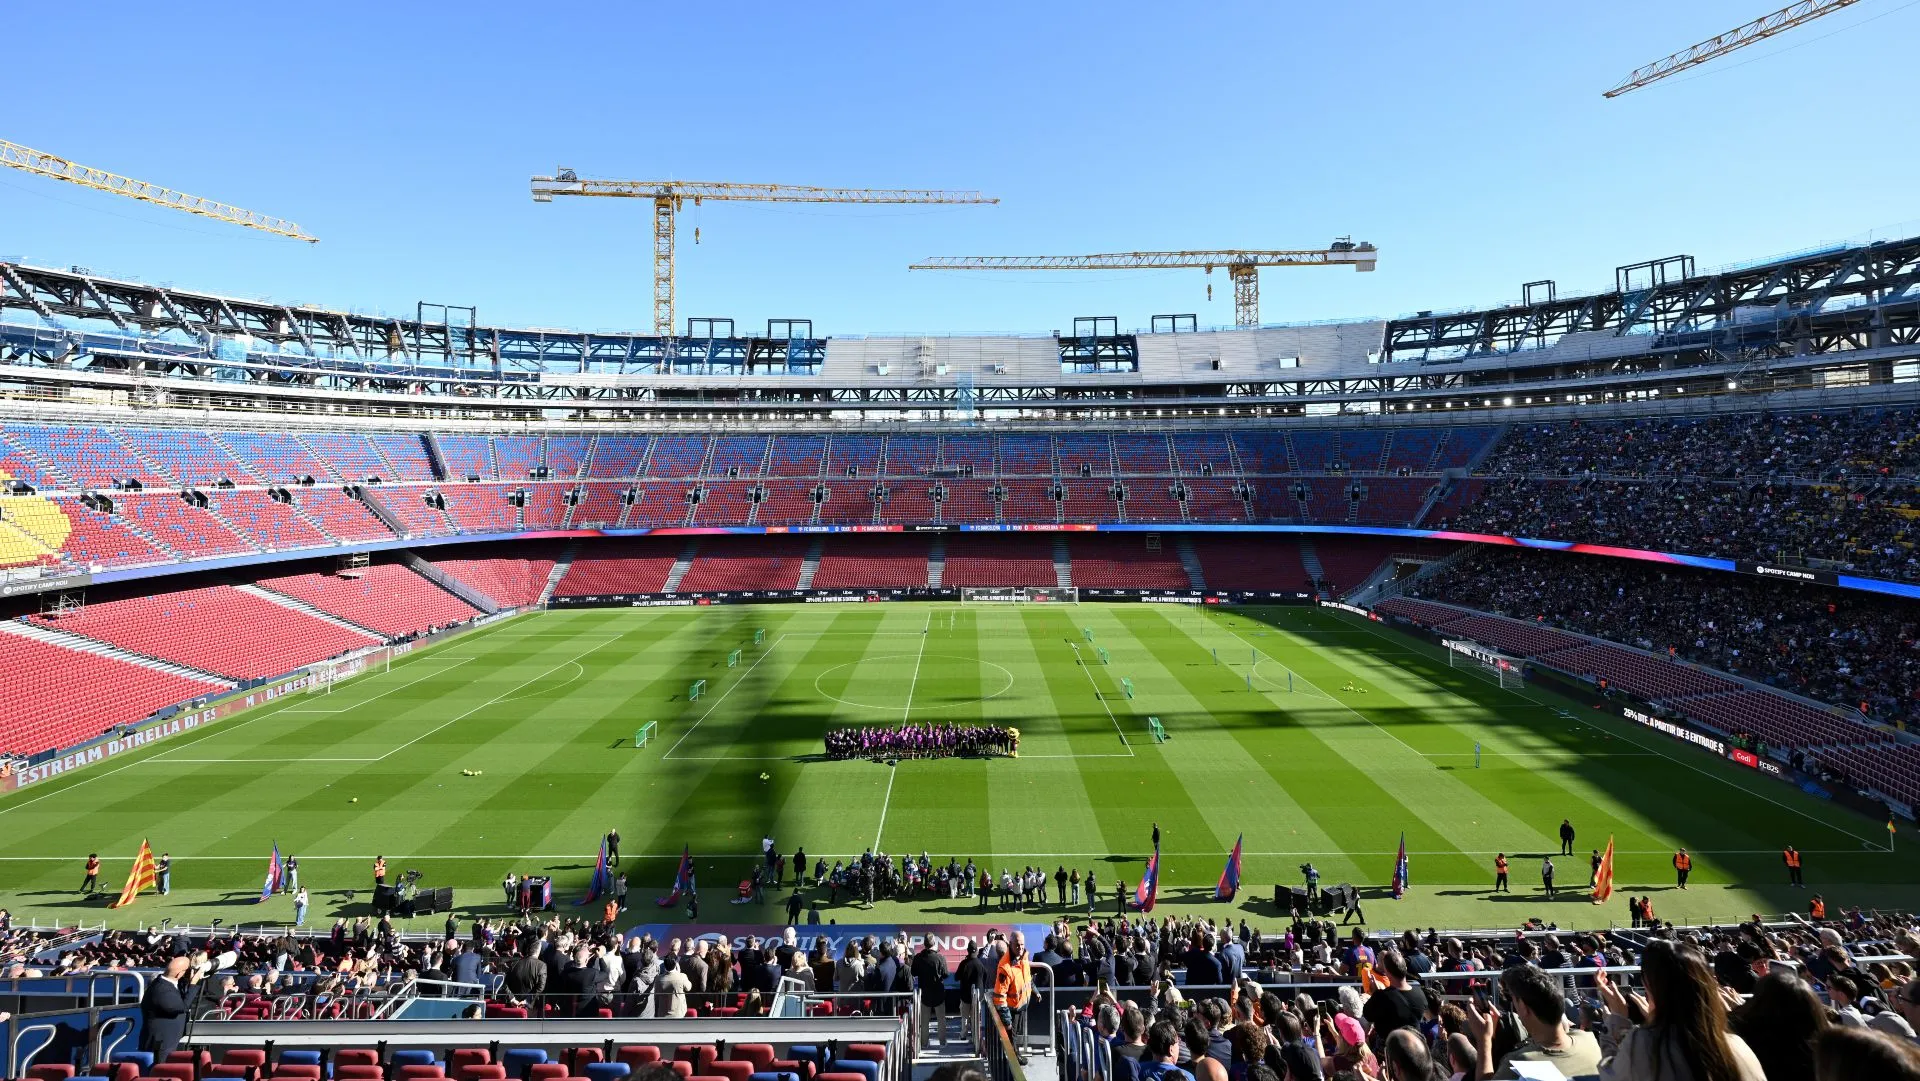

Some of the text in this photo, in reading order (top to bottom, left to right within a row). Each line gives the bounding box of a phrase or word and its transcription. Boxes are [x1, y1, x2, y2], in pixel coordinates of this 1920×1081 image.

[1764, 568, 1786, 576] SPOTIFY
[12, 584, 38, 592] SPOTIFY
[38, 581, 55, 589] CAMP
[1654, 719, 1676, 736] PARTIR
[1676, 726, 1685, 738] DE
[1684, 730, 1690, 740] 3
[17, 746, 103, 788] ESTREAM
[1736, 752, 1779, 774] Codi FCB25
